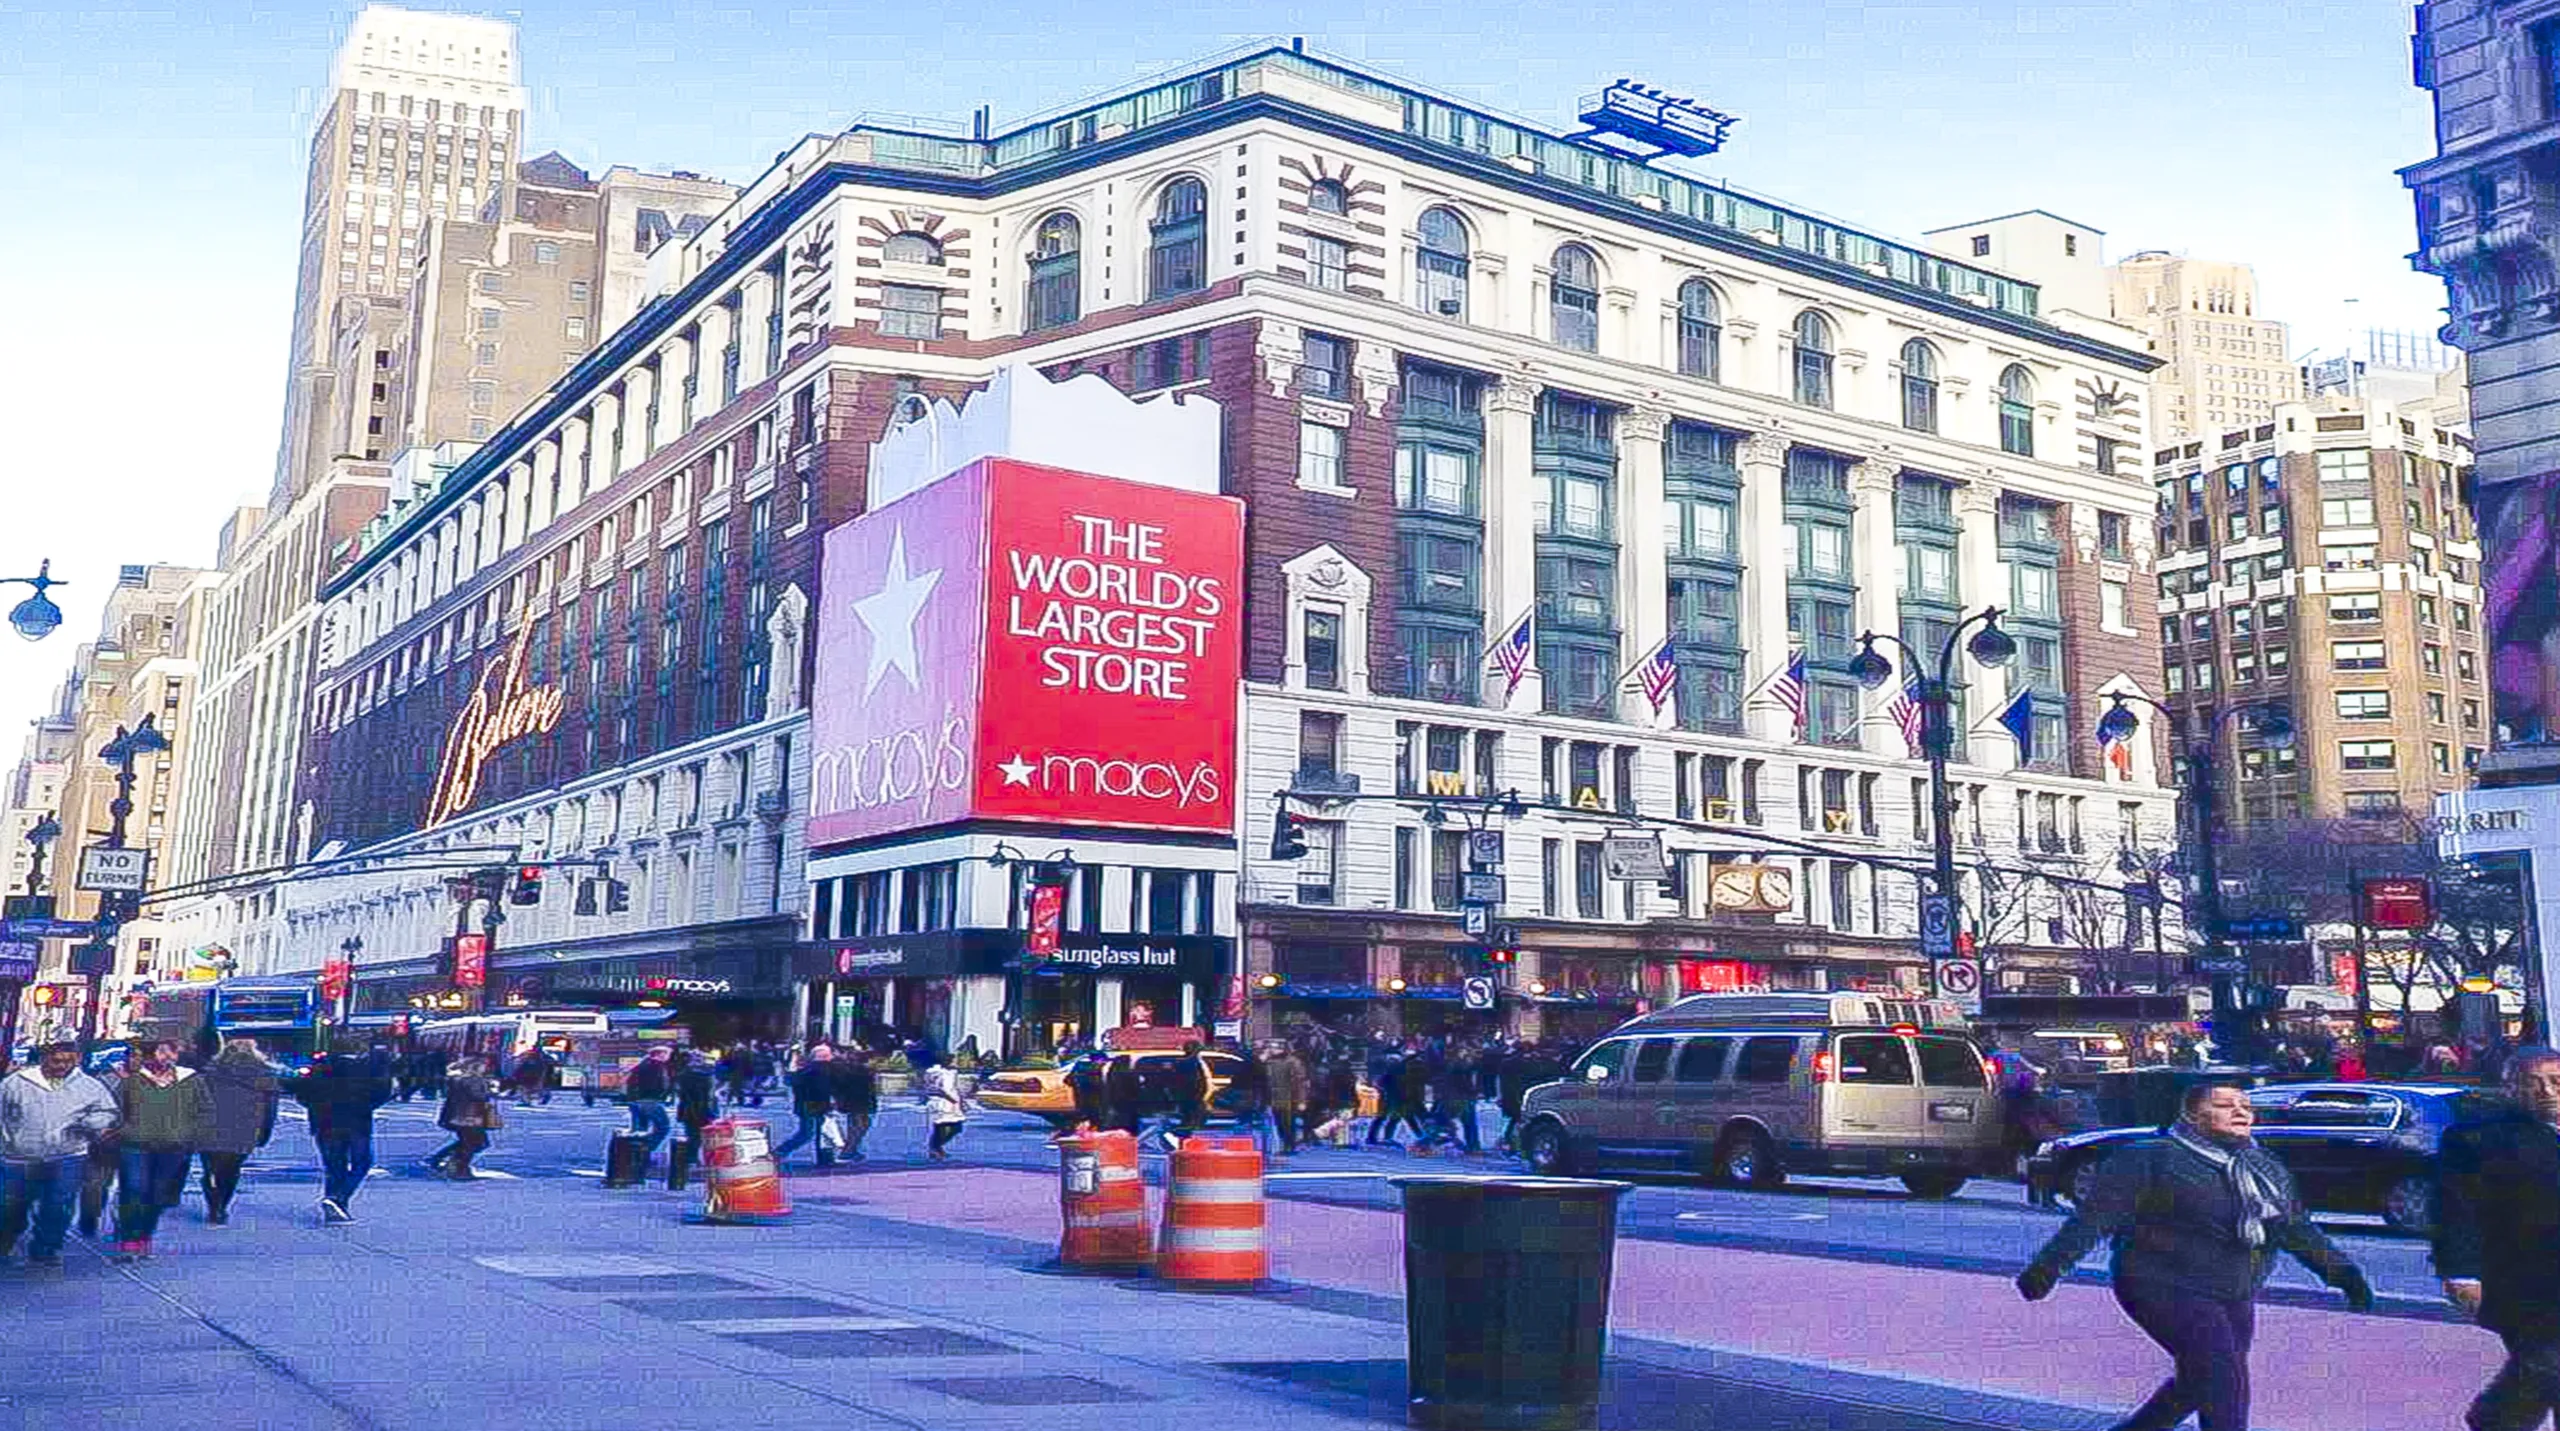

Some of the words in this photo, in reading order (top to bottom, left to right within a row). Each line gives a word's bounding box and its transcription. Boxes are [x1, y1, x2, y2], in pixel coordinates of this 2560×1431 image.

[1073, 514, 1164, 564] THE
[1009, 550, 1222, 616] WORLD'S
[1009, 595, 1215, 657] LARGEST
[1042, 646, 1187, 699] STORE
[1043, 755, 1220, 808] macy's
[99, 855, 131, 868] NO
[1052, 944, 1140, 967] sunglass
